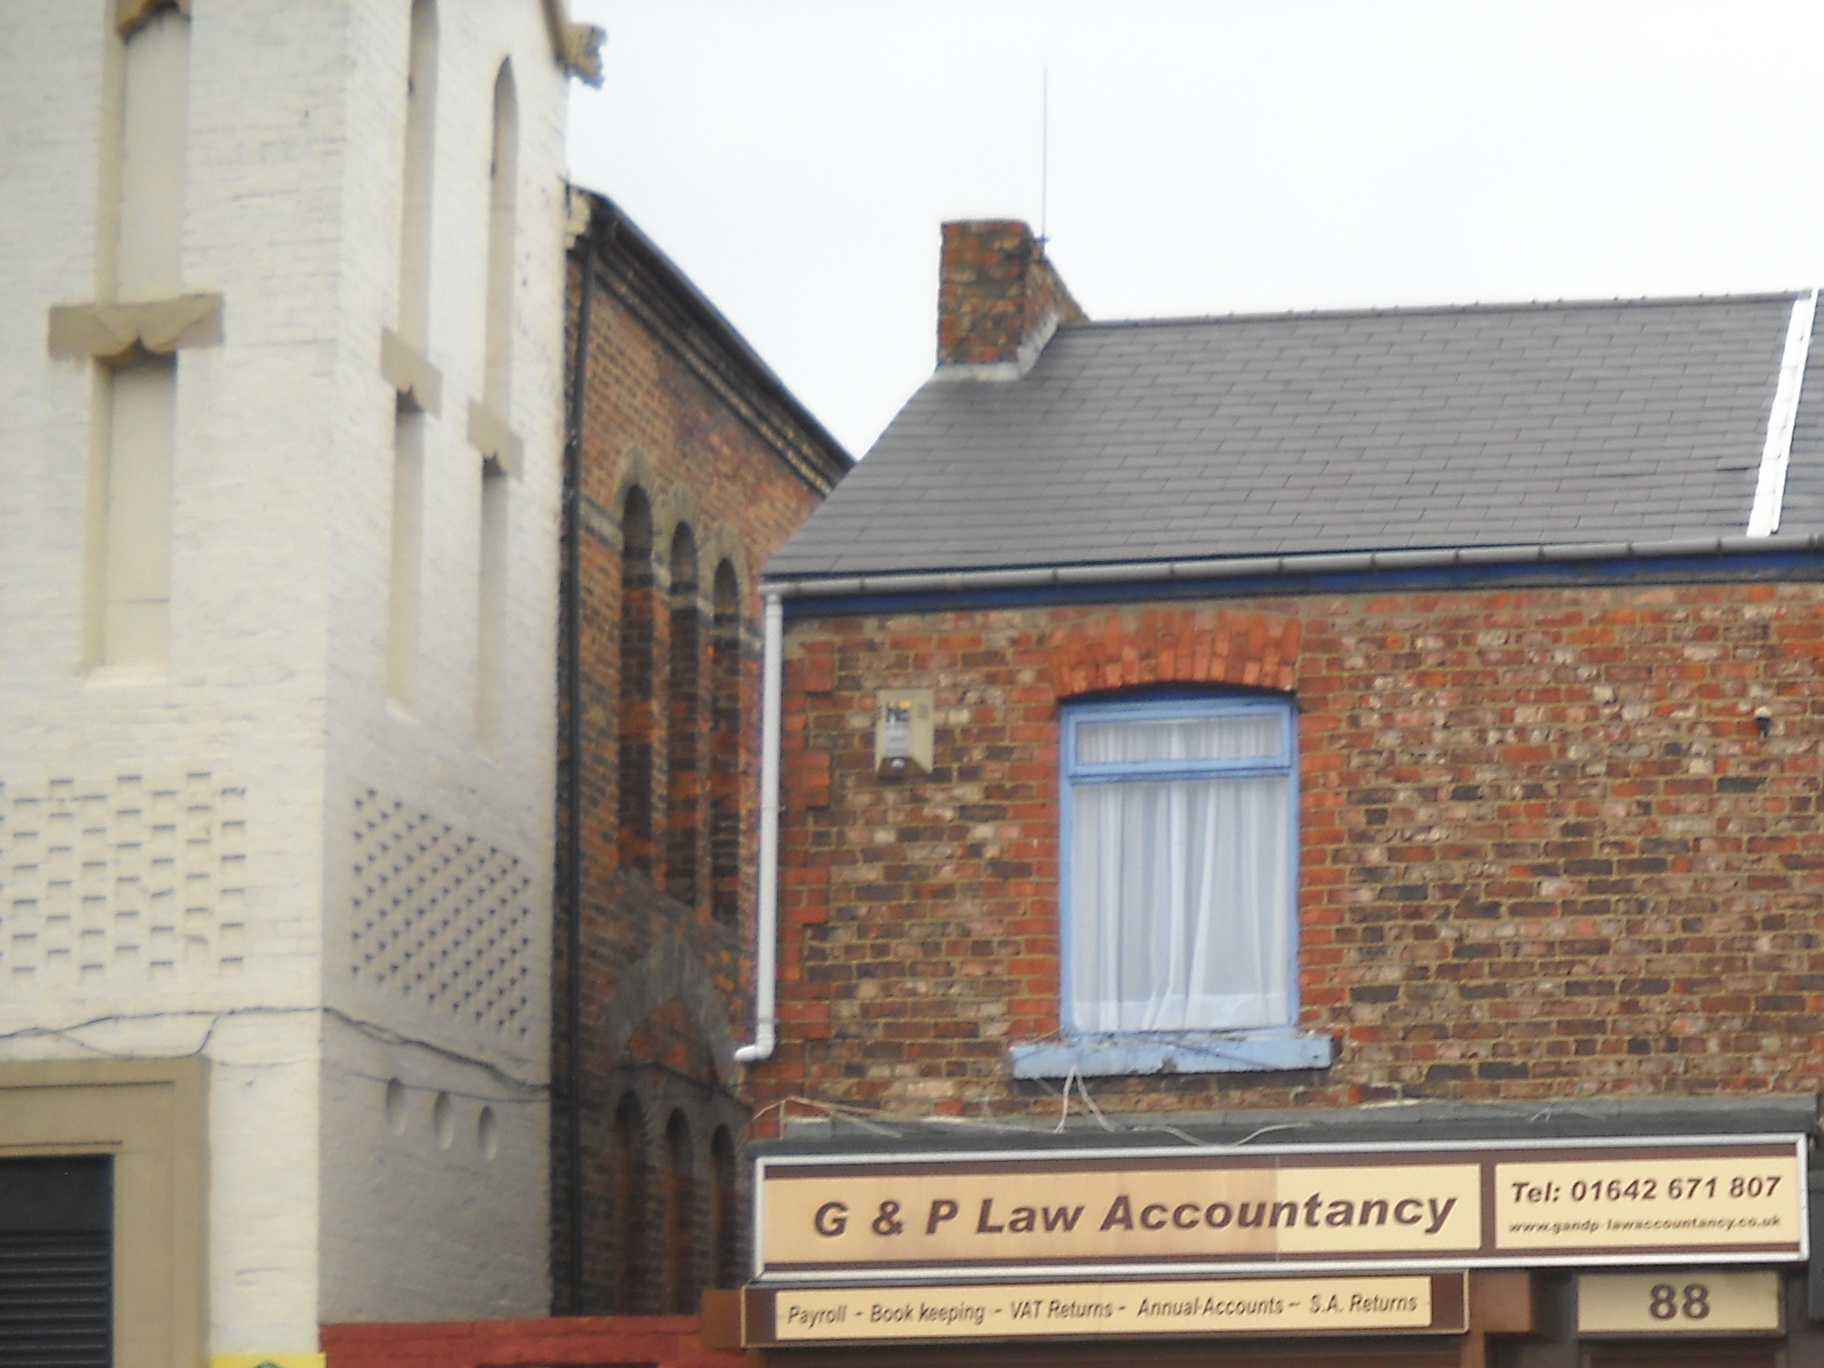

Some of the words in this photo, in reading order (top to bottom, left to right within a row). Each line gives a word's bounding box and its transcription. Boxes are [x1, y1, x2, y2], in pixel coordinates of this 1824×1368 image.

[1511, 1181, 1561, 1203] Tel:
[1571, 1178, 1658, 1201] 01642
[1668, 1177, 1717, 1200] 671
[1730, 1176, 1782, 1199] 807
[814, 1201, 848, 1237] G
[871, 1200, 904, 1236] &
[925, 1199, 959, 1235] P
[976, 1198, 1085, 1235] Law
[1100, 1192, 1458, 1234] Accountancy
[787, 1305, 847, 1329] Payroll
[870, 1303, 913, 1323] Book
[919, 1301, 985, 1326] keeping
[1010, 1300, 1044, 1319] VAT
[1048, 1299, 1112, 1318] Returns
[1310, 1295, 1343, 1315] S.A.
[1350, 1293, 1417, 1313] Returns
[1650, 1284, 1711, 1320] 88
